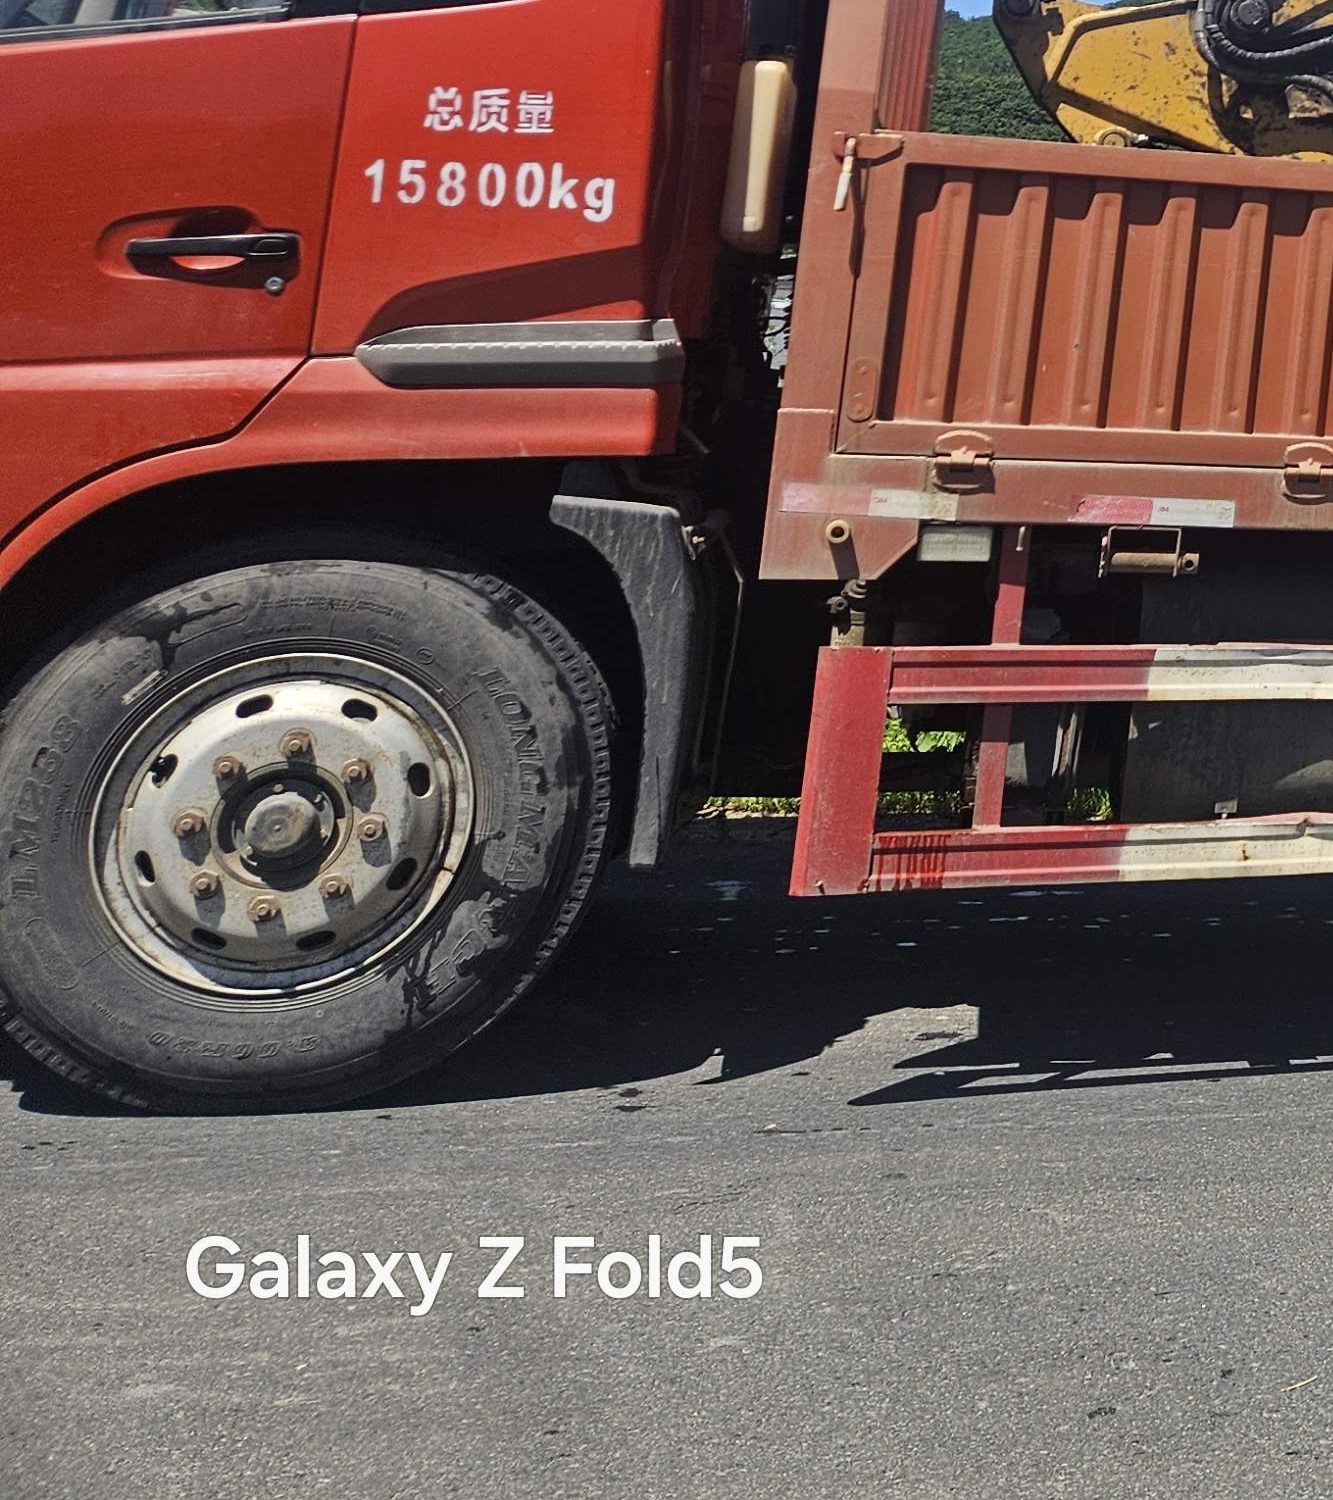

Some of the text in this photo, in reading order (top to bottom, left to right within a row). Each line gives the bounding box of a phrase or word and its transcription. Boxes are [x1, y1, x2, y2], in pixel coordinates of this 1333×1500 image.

[423, 86, 554, 134] 总质量
[363, 158, 615, 223] 15800kg
